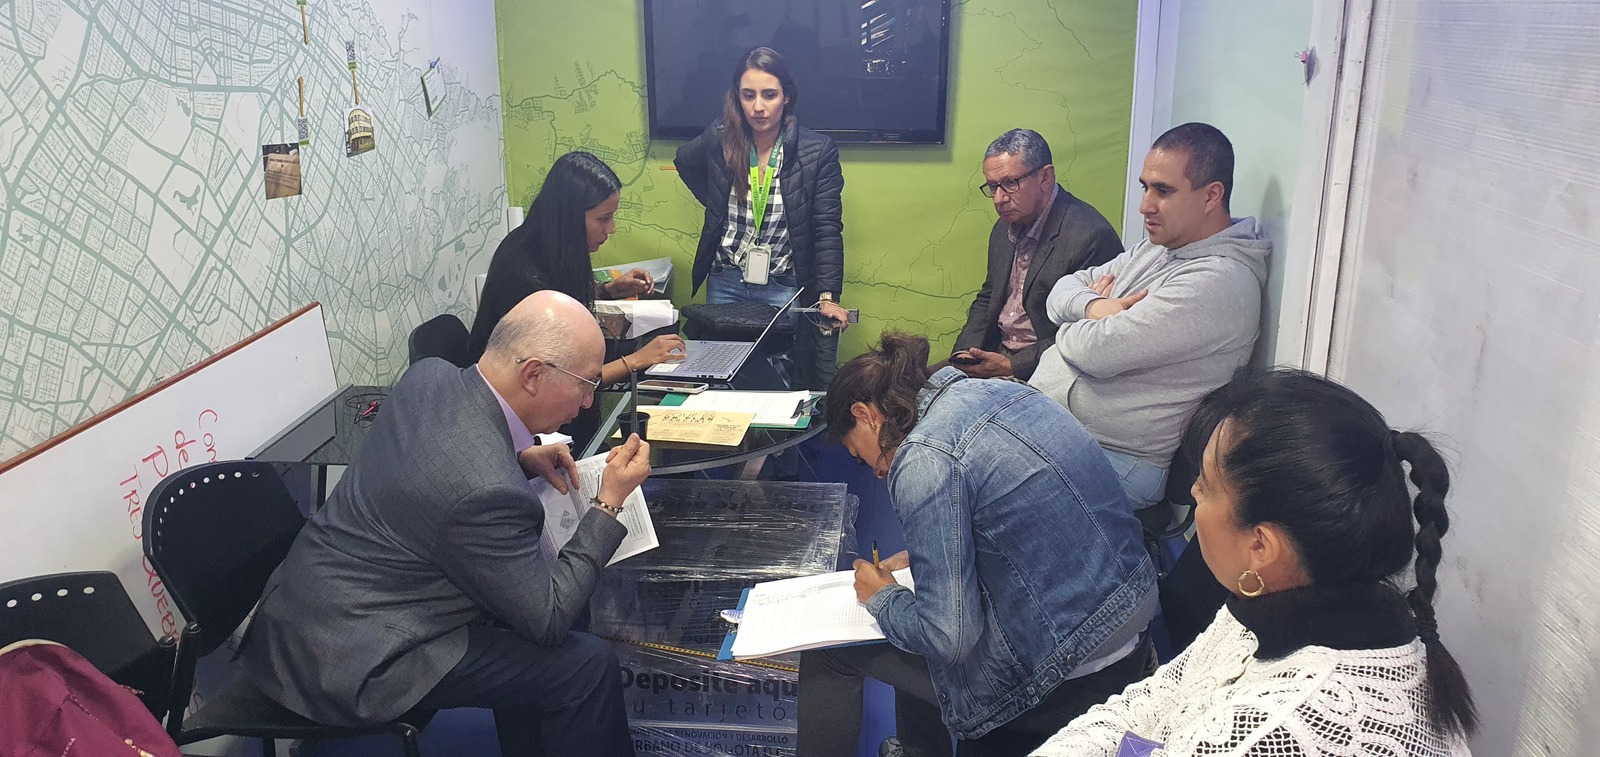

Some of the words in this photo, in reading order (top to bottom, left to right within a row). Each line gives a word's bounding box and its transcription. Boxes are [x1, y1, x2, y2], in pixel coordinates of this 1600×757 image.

[620, 666, 738, 695] Deposite
[746, 679, 798, 702] aqu
[668, 698, 787, 723] tarjetó
[634, 739, 681, 754] RBANO
[736, 733, 789, 744] DESARROLLO
